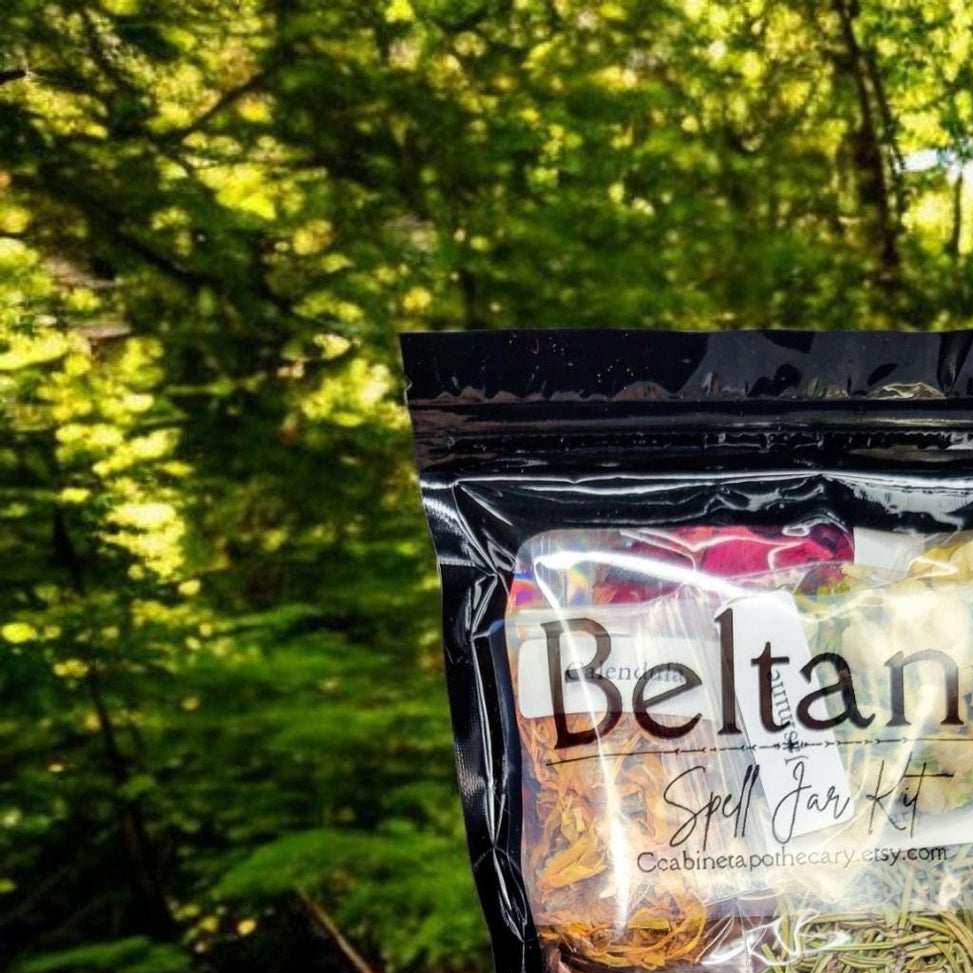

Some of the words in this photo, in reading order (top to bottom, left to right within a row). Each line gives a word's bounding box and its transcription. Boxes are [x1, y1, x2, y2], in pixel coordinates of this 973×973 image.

[664, 764, 760, 851] Spell
[772, 761, 849, 844] Jar
[865, 751, 954, 838] Kit
